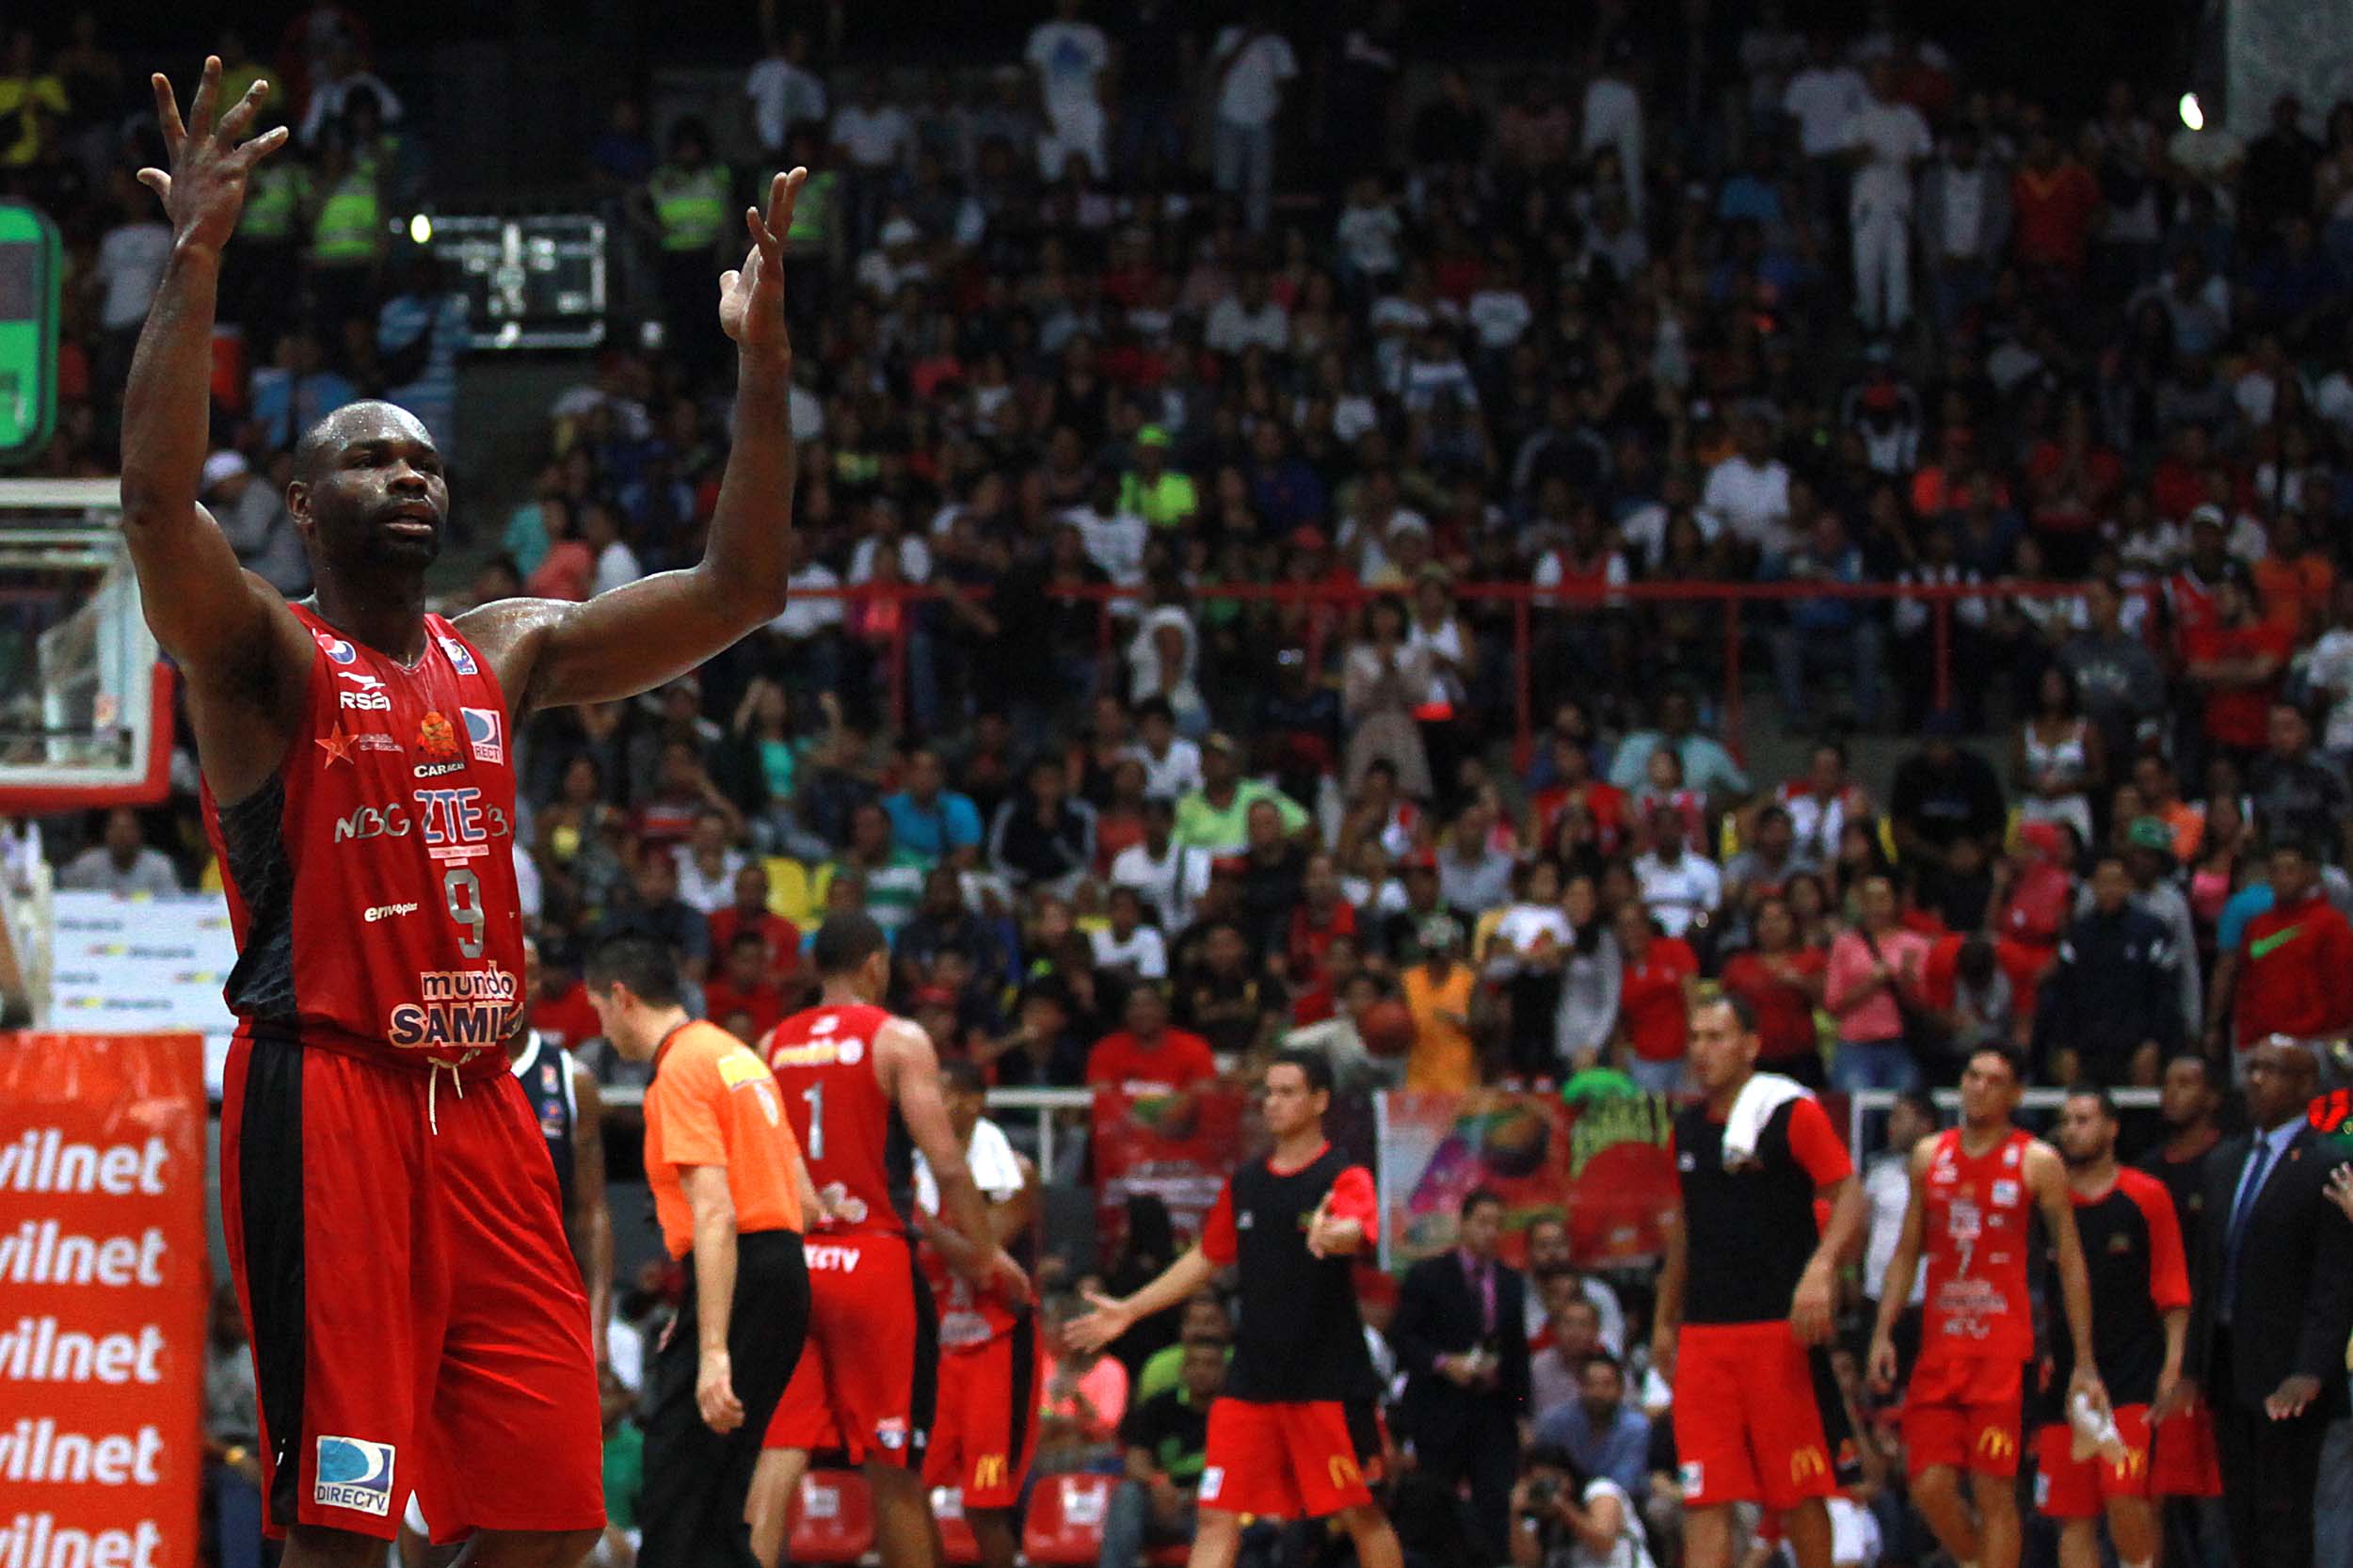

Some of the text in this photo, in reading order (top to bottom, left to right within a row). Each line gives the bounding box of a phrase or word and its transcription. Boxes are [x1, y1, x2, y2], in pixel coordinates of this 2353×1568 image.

[334, 803, 411, 843] NBG
[413, 787, 488, 843] ZTE
[443, 869, 486, 958] 9
[421, 960, 517, 1000] mundo
[803, 1081, 824, 1160] 1
[317, 1486, 386, 1512] DIRECTV
